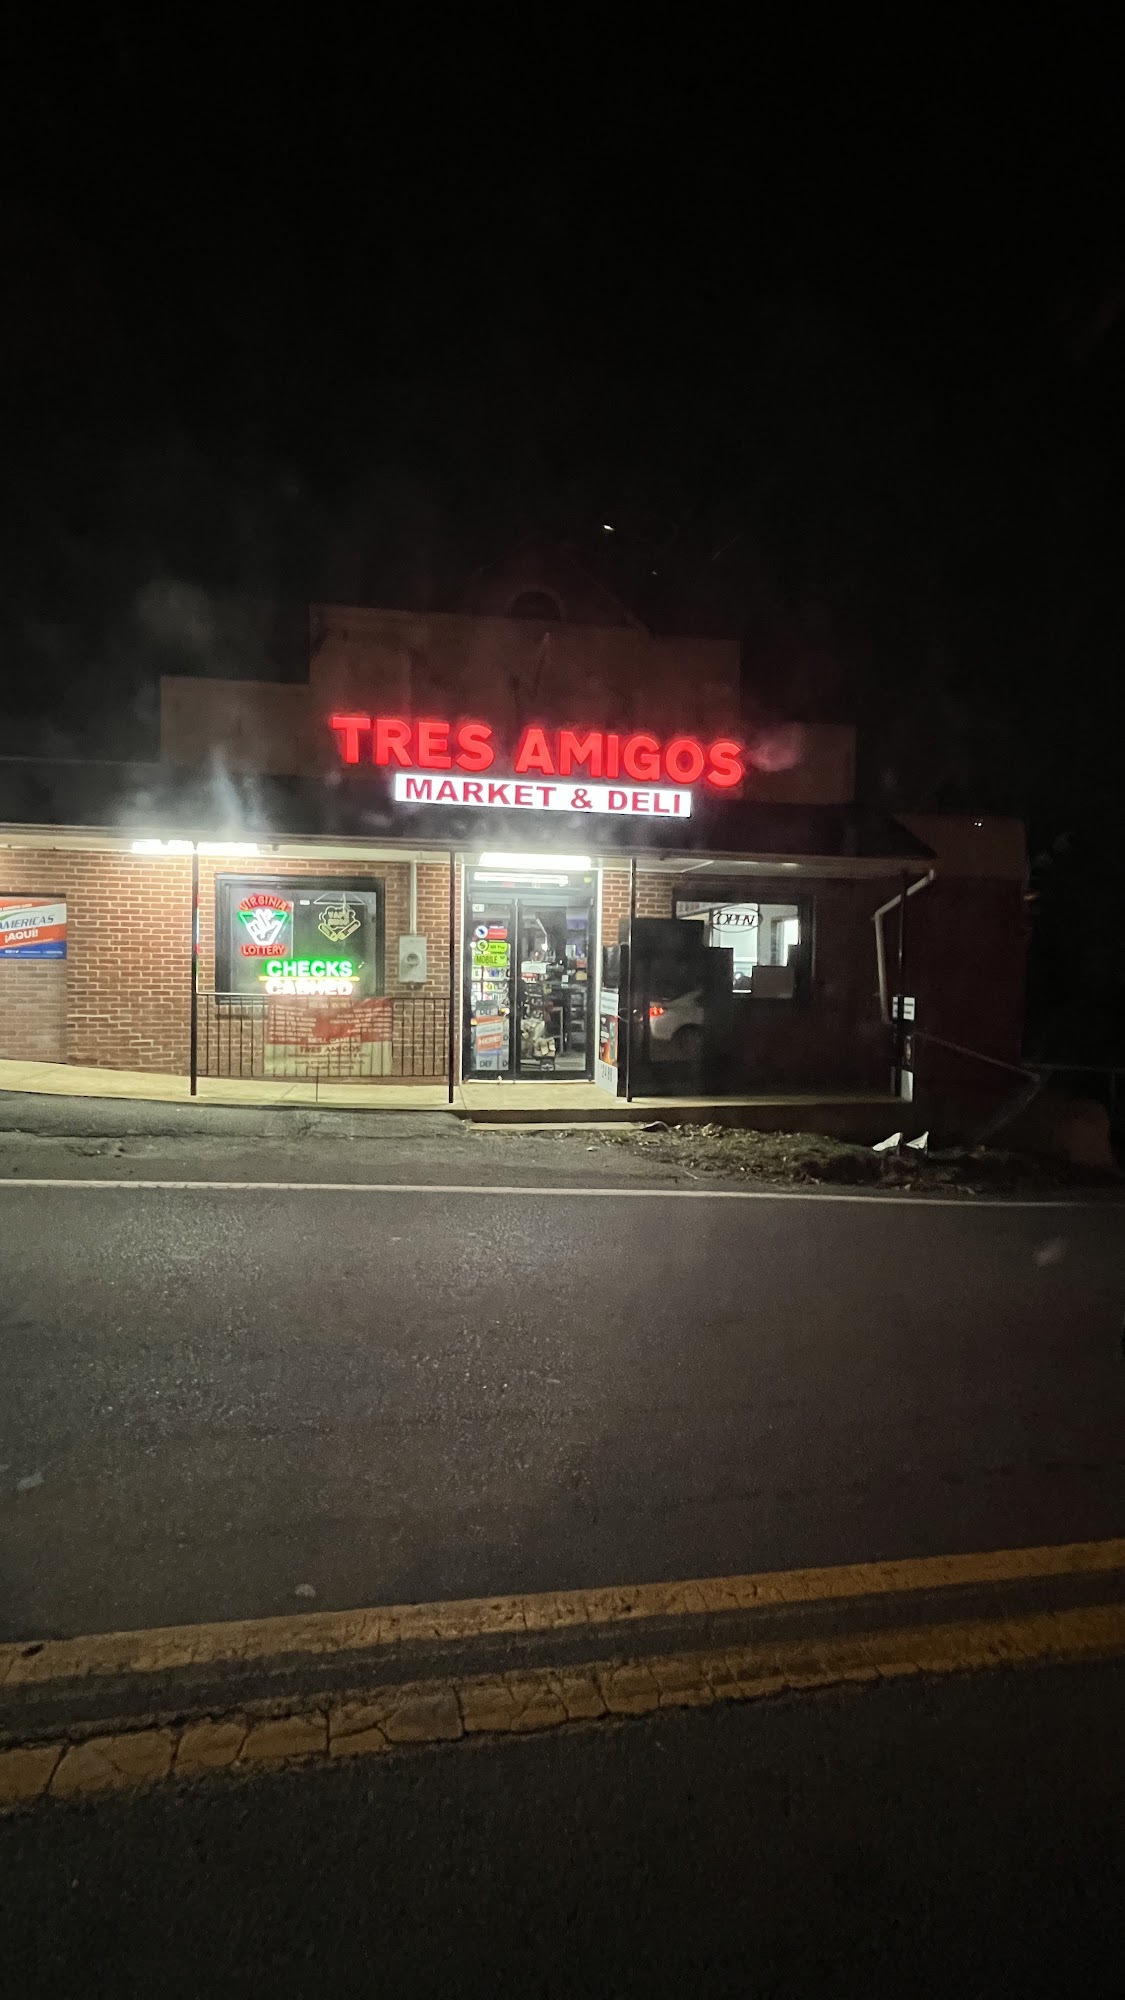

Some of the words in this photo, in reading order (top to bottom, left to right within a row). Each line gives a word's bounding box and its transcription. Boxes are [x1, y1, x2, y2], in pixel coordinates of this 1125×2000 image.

[331, 715, 495, 771] TRES
[514, 728, 745, 788] AMIGOS
[405, 778, 557, 808] MARKET
[570, 788, 593, 810] &
[608, 789, 681, 815] DELI
[239, 895, 287, 911] VIRGINIA
[241, 945, 286, 956] LOTTERY
[476, 955, 498, 965] MOBILE
[266, 960, 353, 977] CHECKS
